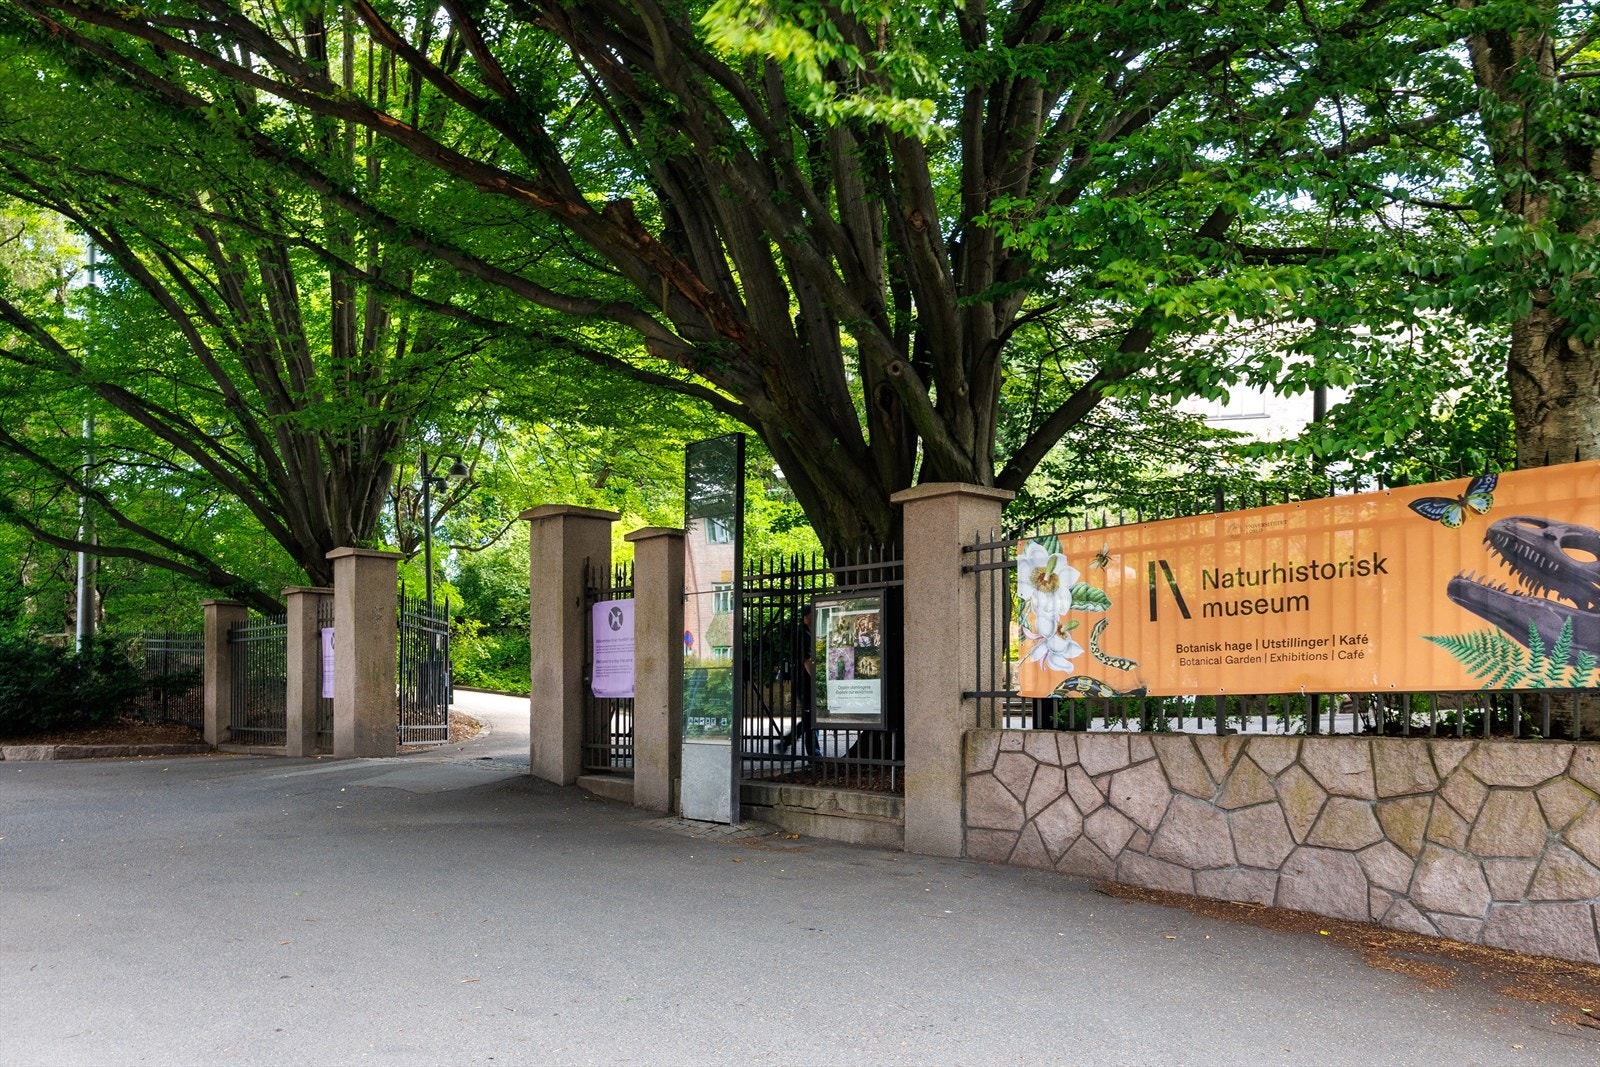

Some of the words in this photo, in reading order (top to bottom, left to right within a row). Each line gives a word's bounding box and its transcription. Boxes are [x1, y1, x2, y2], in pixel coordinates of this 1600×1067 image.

[1202, 552, 1388, 590] Naturhistorisk
[1202, 594, 1310, 618] museum
[1176, 642, 1222, 654] Botanisk
[1224, 641, 1253, 653] hage
[1262, 637, 1330, 650] Utstillinger
[1339, 633, 1369, 646] Kafé
[1179, 656, 1222, 667] Botanical
[1225, 654, 1262, 665] Garden
[1270, 651, 1329, 663] Exhibitions
[1337, 649, 1365, 660] Café
